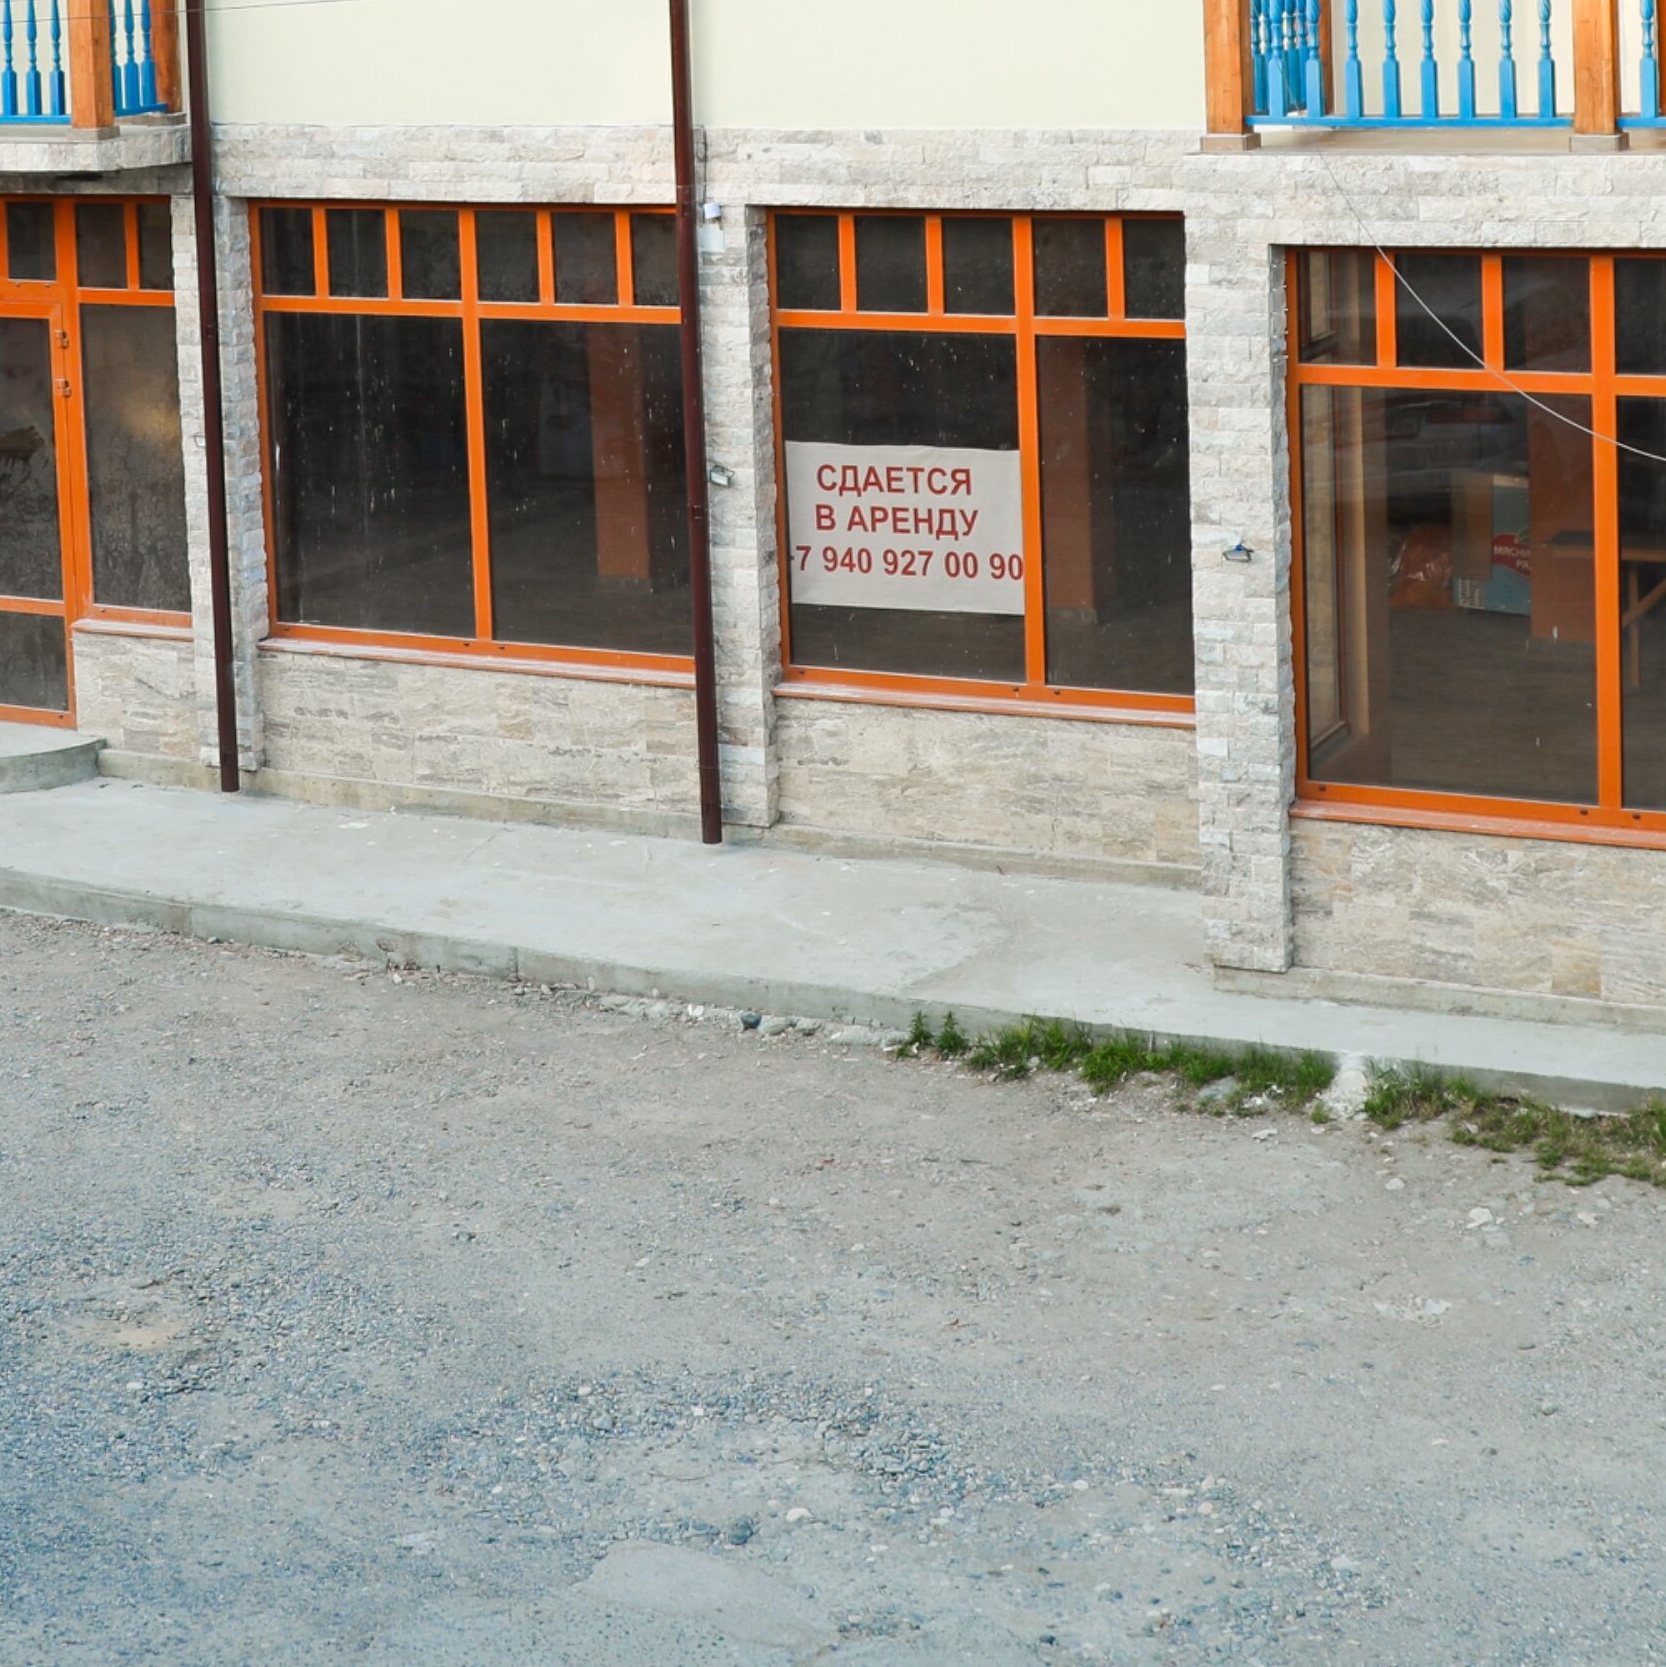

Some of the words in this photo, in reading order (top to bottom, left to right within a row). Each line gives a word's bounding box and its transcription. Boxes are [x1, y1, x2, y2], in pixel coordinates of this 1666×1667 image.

[817, 464, 972, 497] СДАЕТСЯ
[815, 504, 836, 531] В
[847, 505, 978, 541] АРЕНДУ
[822, 546, 873, 574] 940
[883, 548, 933, 576] 927
[944, 551, 979, 579] 00
[989, 553, 1023, 581] 90
